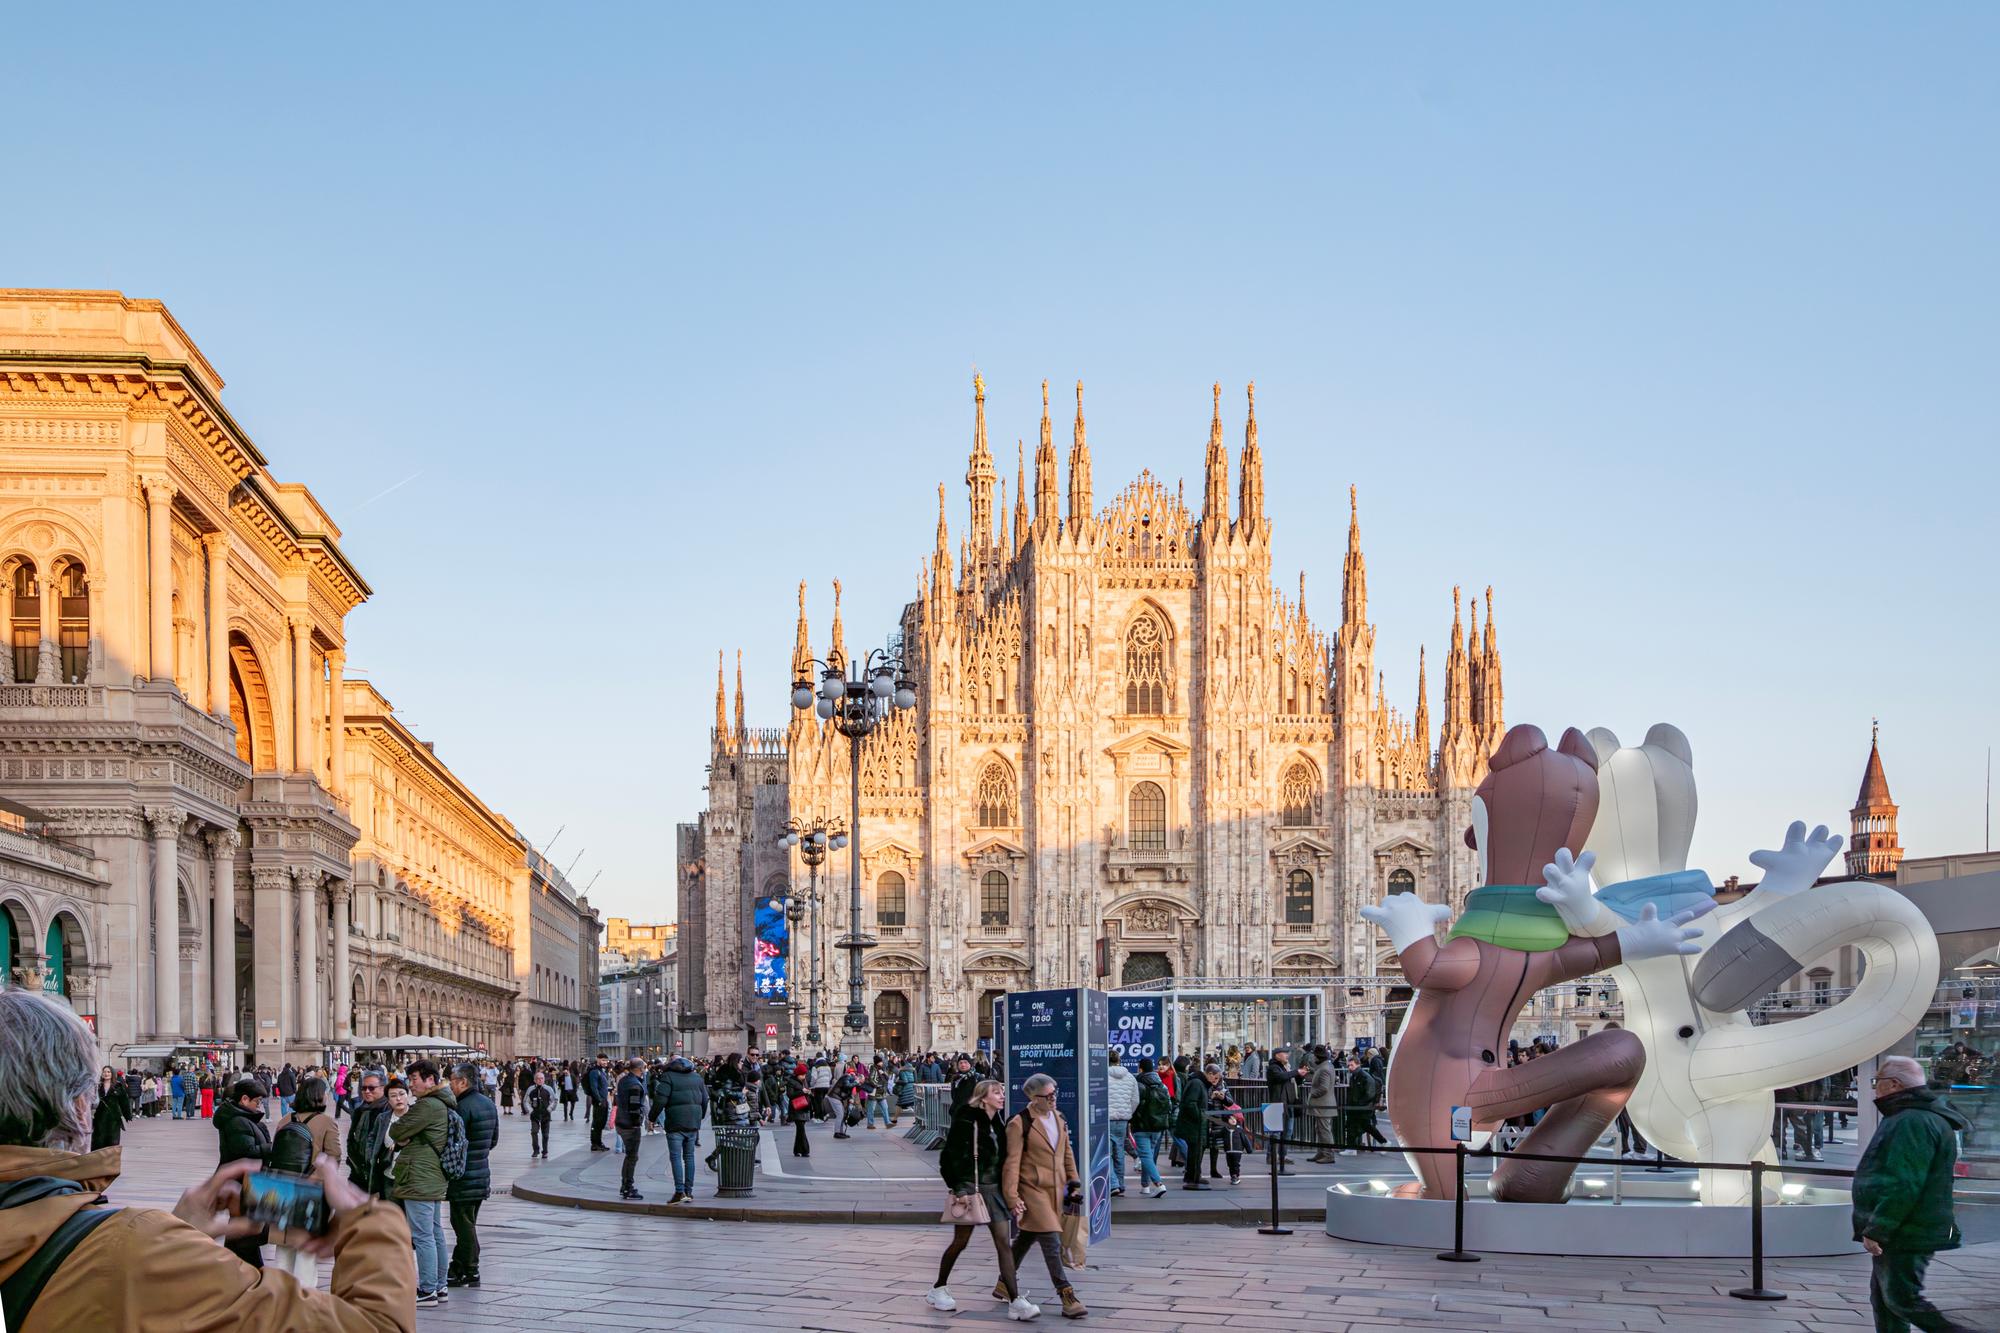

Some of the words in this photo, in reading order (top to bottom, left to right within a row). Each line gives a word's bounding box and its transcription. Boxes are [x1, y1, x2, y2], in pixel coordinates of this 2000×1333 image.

[1031, 1002, 1045, 1010] ONE
[1037, 1008, 1054, 1016] YEAR
[1040, 1014, 1051, 1022] GO
[1118, 1015, 1155, 1030] ONE
[1108, 1029, 1143, 1044] EAR
[1020, 1049, 1044, 1058] SPORT
[1044, 1048, 1074, 1058] VILLAGE
[1128, 1043, 1155, 1057] GO
